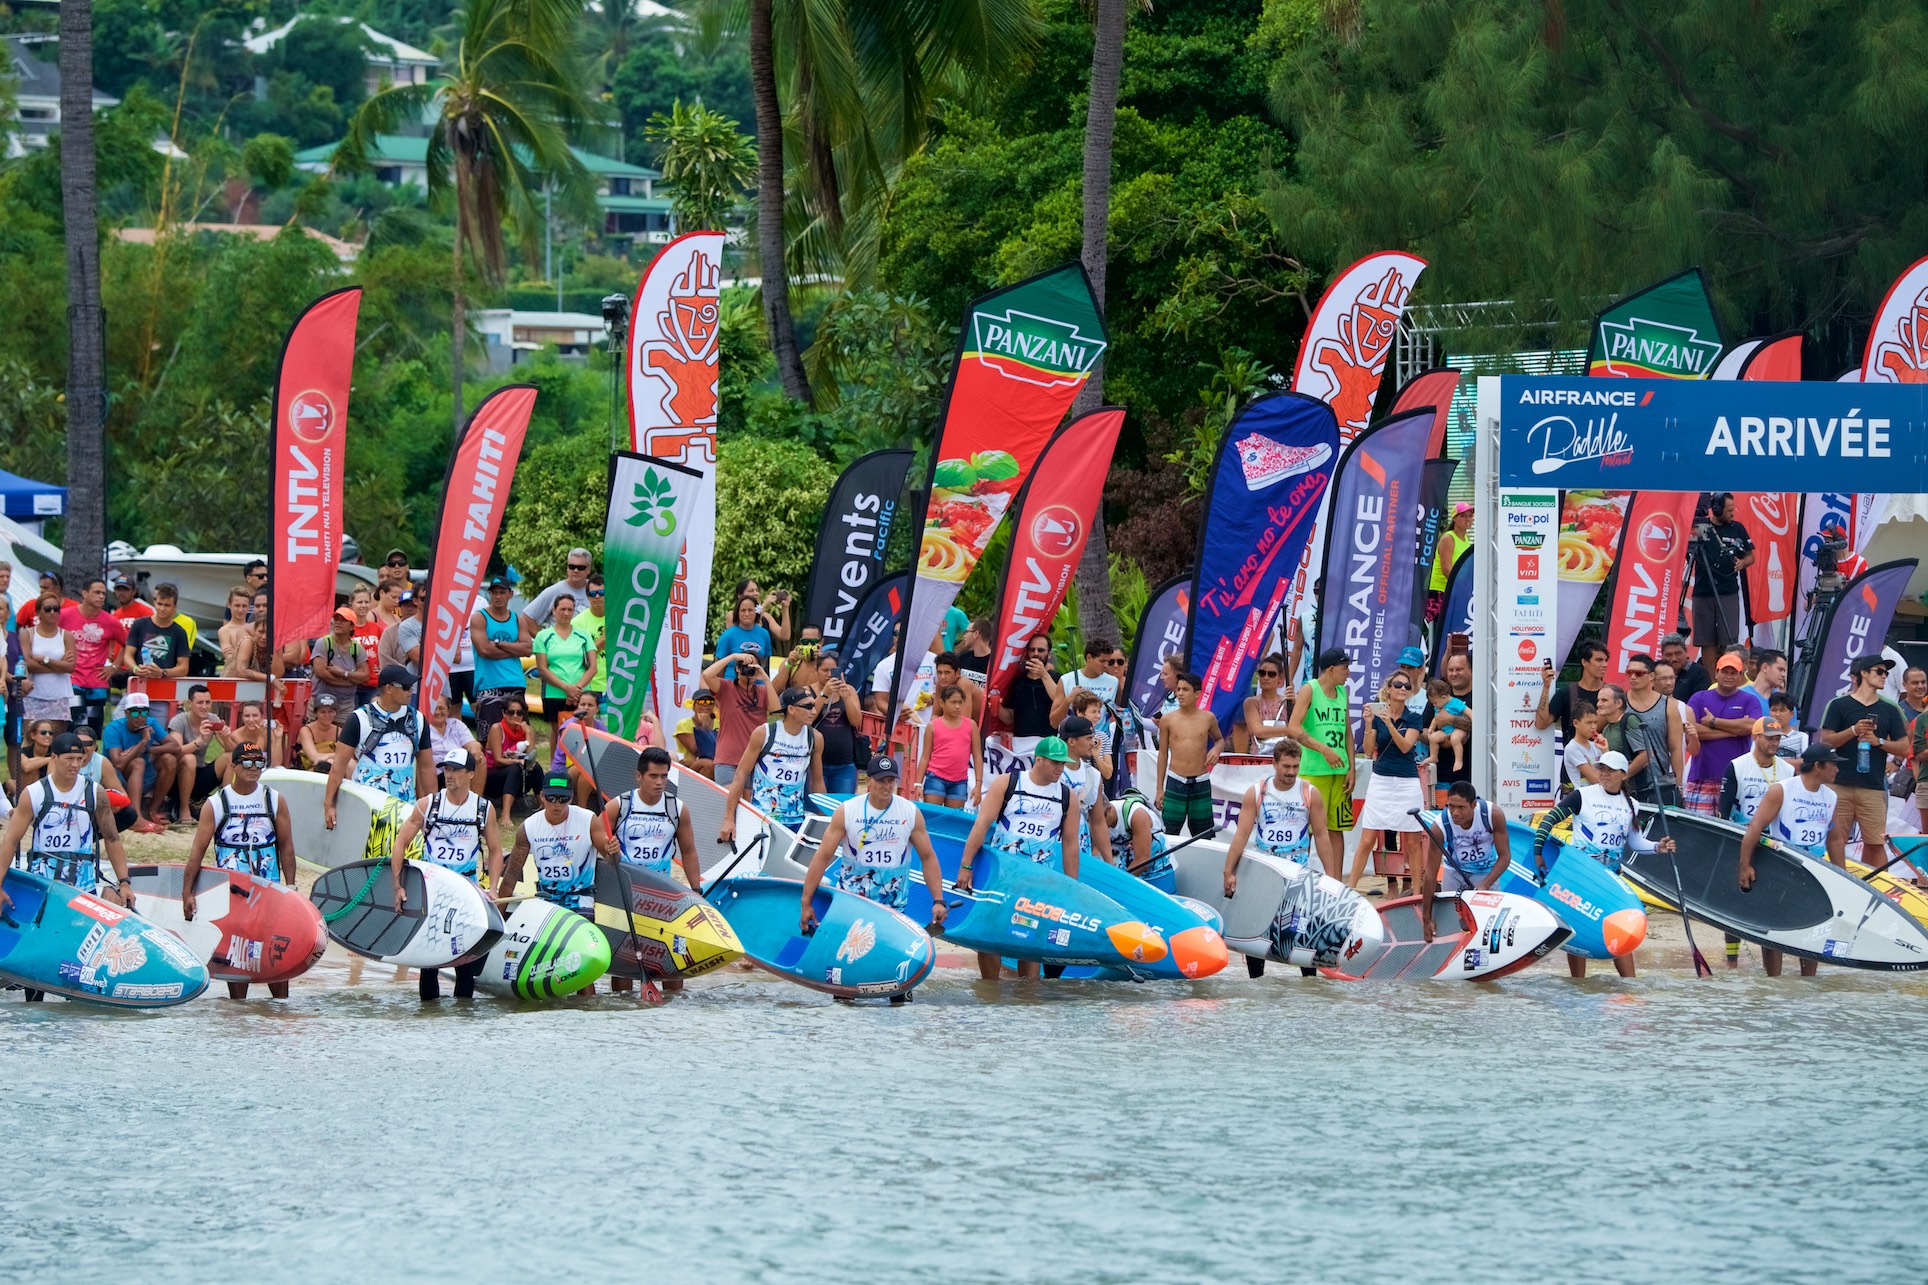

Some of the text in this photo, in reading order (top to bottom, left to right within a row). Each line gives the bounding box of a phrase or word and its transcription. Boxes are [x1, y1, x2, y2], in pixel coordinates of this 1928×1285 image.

[983, 321, 1086, 370] PANZANI
[1611, 331, 1705, 374] PANZANI
[1519, 389, 1635, 406] AIRFRANCE
[1527, 411, 1632, 468] Paddle
[1705, 408, 1891, 457] ARRIVÉE
[287, 445, 319, 562] TNTV
[322, 447, 332, 564] TAHITI NUI TELEVISION
[1385, 479, 1400, 543] PARTNER
[447, 427, 506, 615] AIR TAHITI
[1267, 502, 1293, 528] te
[1508, 512, 1549, 525] Petropol
[873, 499, 895, 561] Pacific
[1419, 506, 1440, 567] Pacific
[1513, 535, 1543, 546] PANZANI
[823, 492, 882, 638] Events
[1377, 543, 1394, 604] OFFICIAL
[1658, 568, 1672, 626] TELEVISION
[999, 556, 1051, 671] TNTV
[1617, 562, 1659, 674] TNTV
[1371, 608, 1387, 668] OFFICIEL
[1510, 720, 1534, 729] TNTV
[1511, 734, 1543, 748] Kellogg's
[384, 752, 408, 765] 317
[775, 767, 800, 783] 261
[627, 815, 666, 823] AIRFRANCE
[1017, 821, 1045, 838] 295
[1267, 829, 1293, 842] 269
[1600, 832, 1622, 847] 280
[1801, 829, 1823, 843] 291
[44, 834, 71, 848] 302
[437, 846, 465, 861] 275
[633, 846, 660, 860] 256
[865, 850, 892, 863] 315
[1461, 847, 1485, 862] 285
[544, 865, 570, 878] 253
[635, 898, 678, 918] NAISH
[704, 906, 732, 939] NAISH
[690, 955, 726, 975] NAISH
